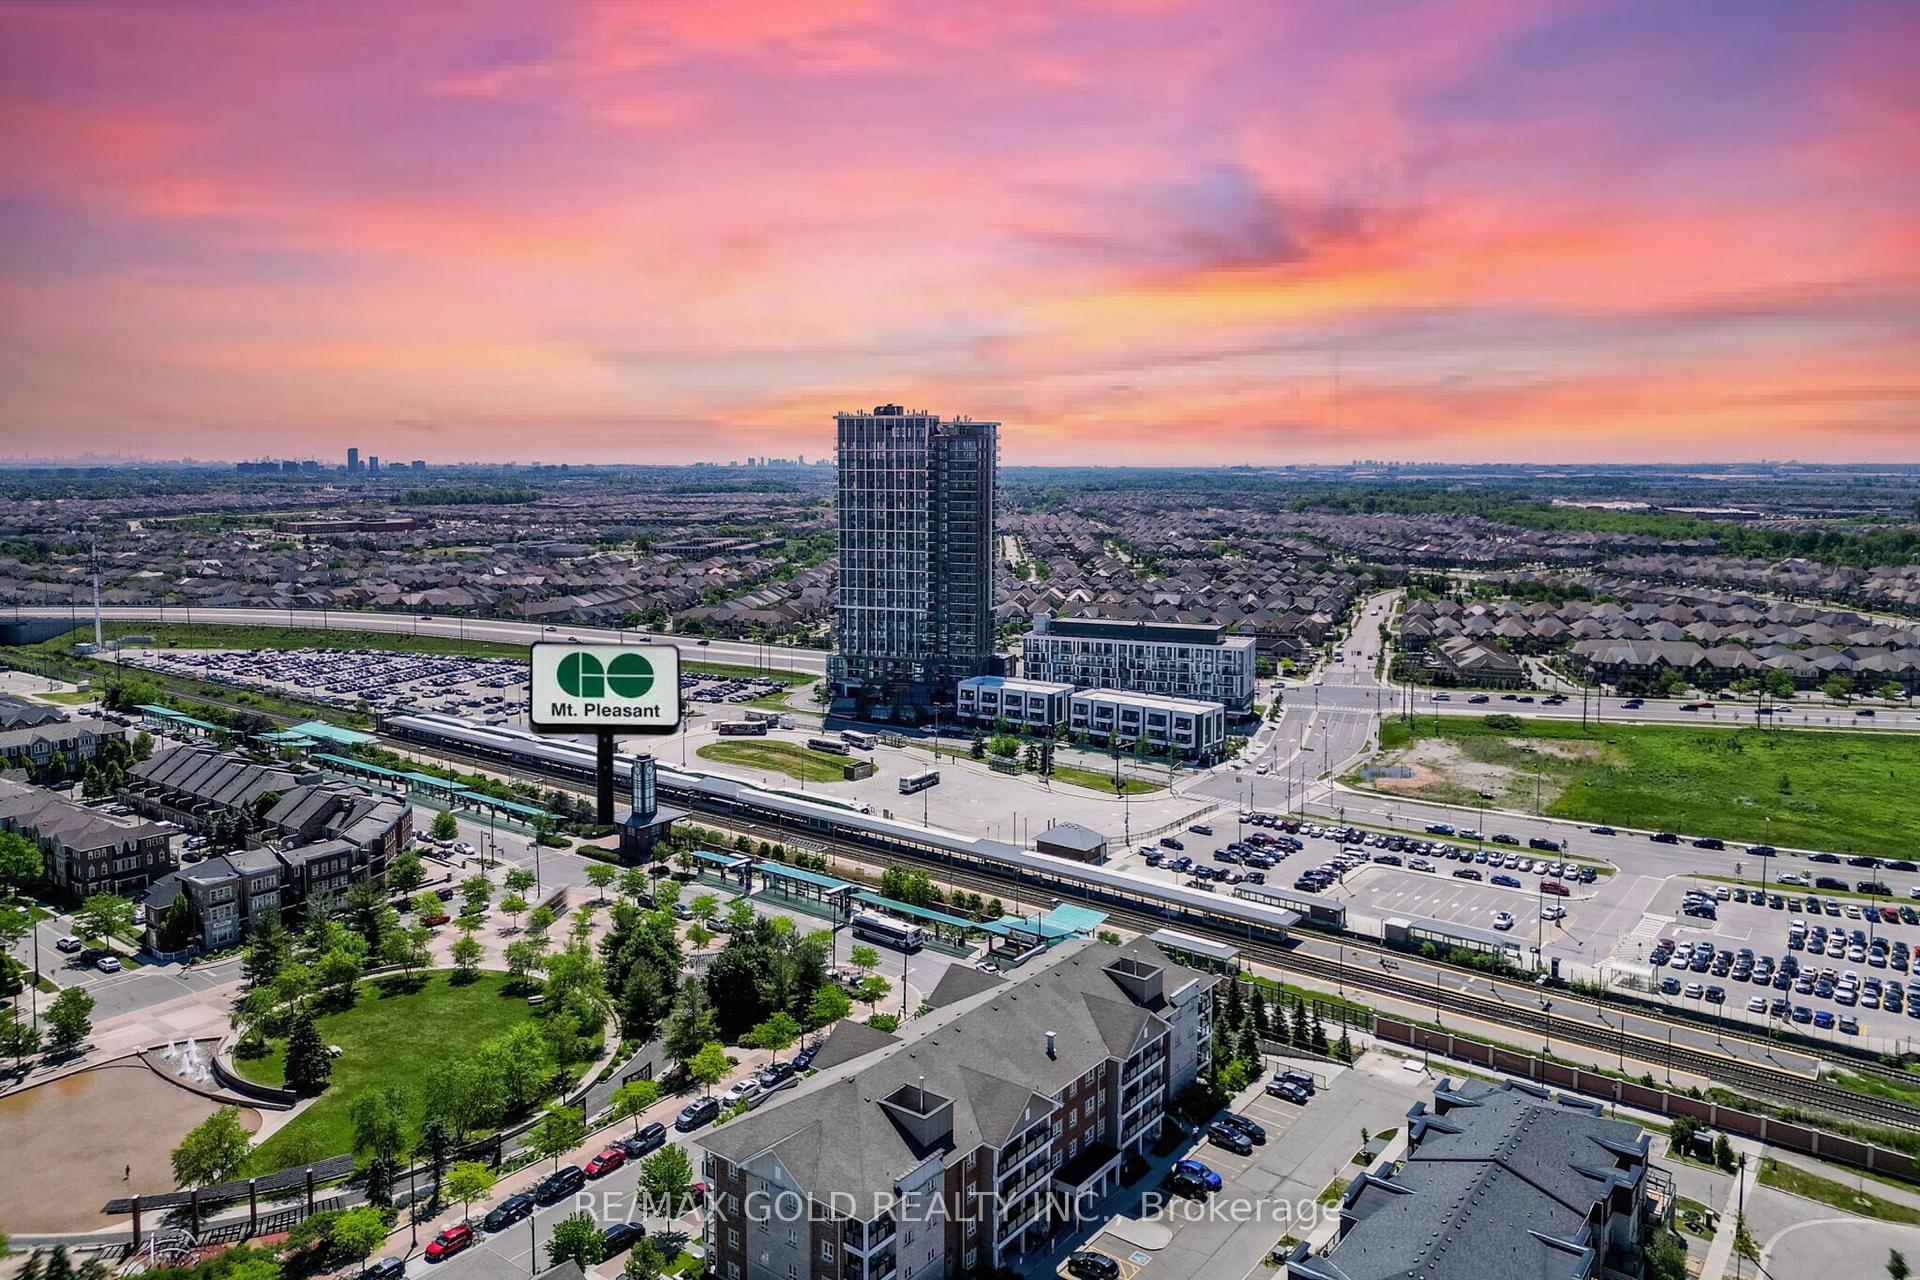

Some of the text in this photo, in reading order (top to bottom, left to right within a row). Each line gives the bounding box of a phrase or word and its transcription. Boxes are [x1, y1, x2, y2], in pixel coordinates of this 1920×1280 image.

[557, 652, 653, 698] GO
[551, 703, 661, 718] Mt. Pleasant
